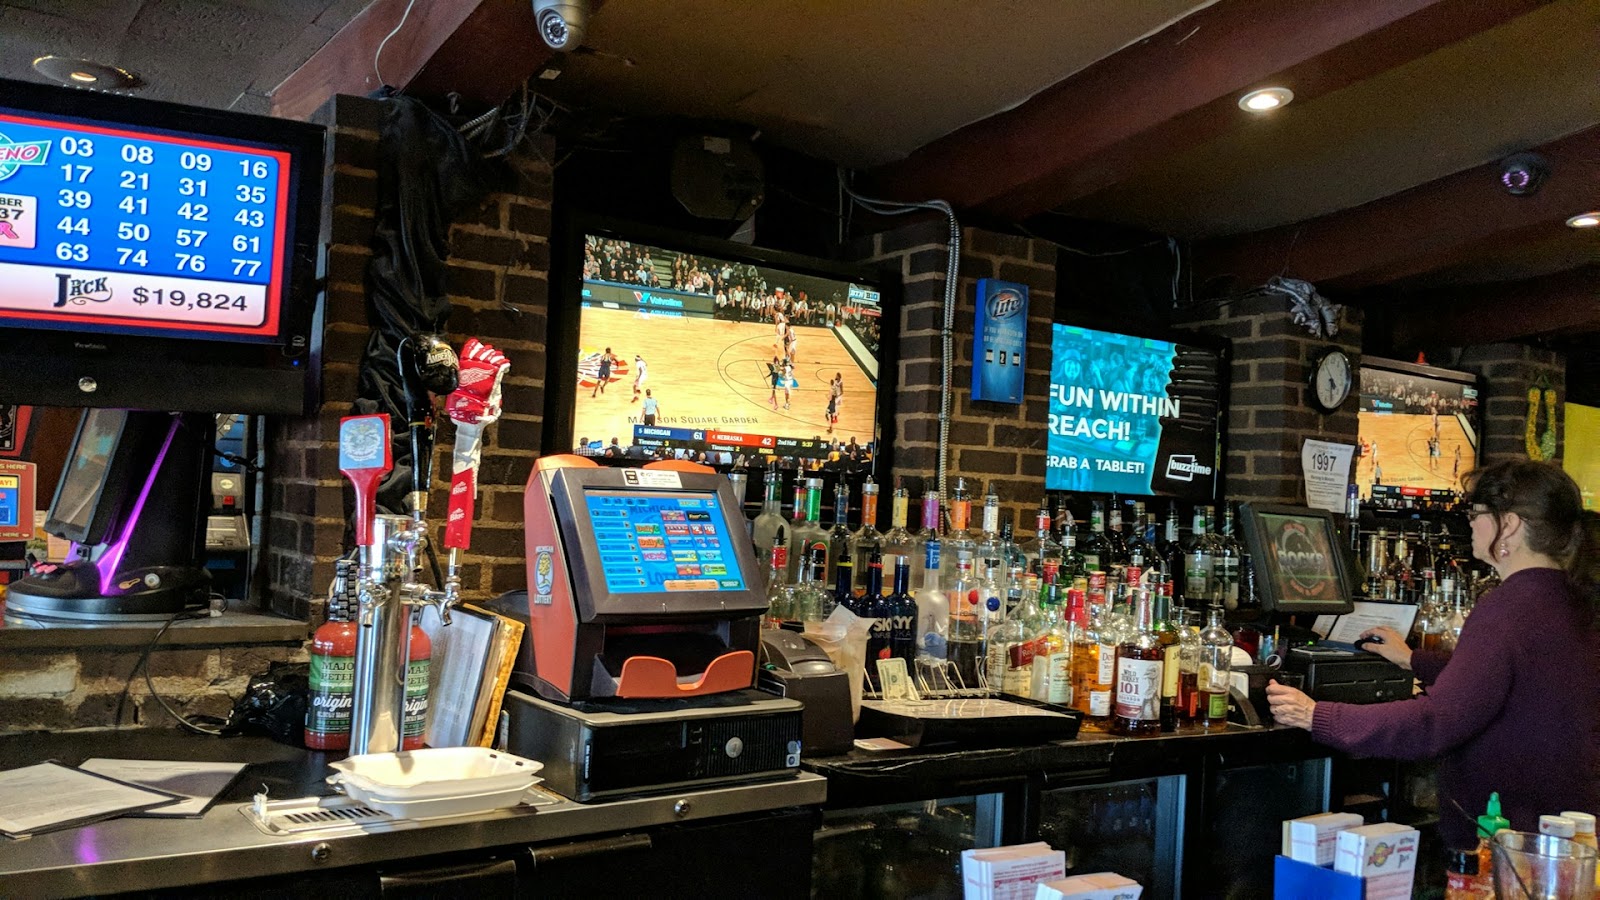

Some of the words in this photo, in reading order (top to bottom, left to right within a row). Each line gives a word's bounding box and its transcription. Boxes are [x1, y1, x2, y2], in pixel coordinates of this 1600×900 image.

[60, 136, 94, 157] 03
[121, 144, 154, 164] 08
[180, 151, 212, 171] 09
[239, 159, 268, 179] 16
[61, 163, 93, 183] 17
[120, 170, 149, 190] 21
[178, 177, 207, 197] 31
[235, 184, 266, 204] 35
[58, 189, 92, 209] 39
[119, 195, 148, 215] 41
[177, 202, 208, 222] 42
[234, 209, 265, 228] 43
[56, 216, 90, 236] 44
[117, 222, 150, 242] 50
[175, 228, 208, 247] 57
[232, 234, 260, 253] 61
[56, 242, 89, 262] 63
[116, 247, 148, 267] 74
[174, 253, 206, 272] 76
[231, 258, 262, 277] 77
[132, 286, 248, 311] $19,824
[1100, 389, 1181, 419] WITHIN
[680, 416, 720, 424] SQUARE
[721, 416, 759, 424] GARDEN
[1047, 414, 1131, 441] REACH!
[638, 438, 663, 446] Timeouts:
[643, 428, 671, 437] MICHIGAN
[693, 431, 704, 440] 61
[716, 434, 744, 442] NEBRASKA
[761, 437, 772, 446] 42
[711, 444, 734, 452] Timeouts:
[1080, 457, 1090, 470] A
[1096, 459, 1145, 474] TABLET!
[1170, 459, 1212, 476] buzztime
[1312, 453, 1337, 472] 1997
[321, 661, 354, 671] MAJO
[1120, 682, 1139, 695] 101
[313, 694, 352, 712] origin
[405, 698, 428, 715] rigin
